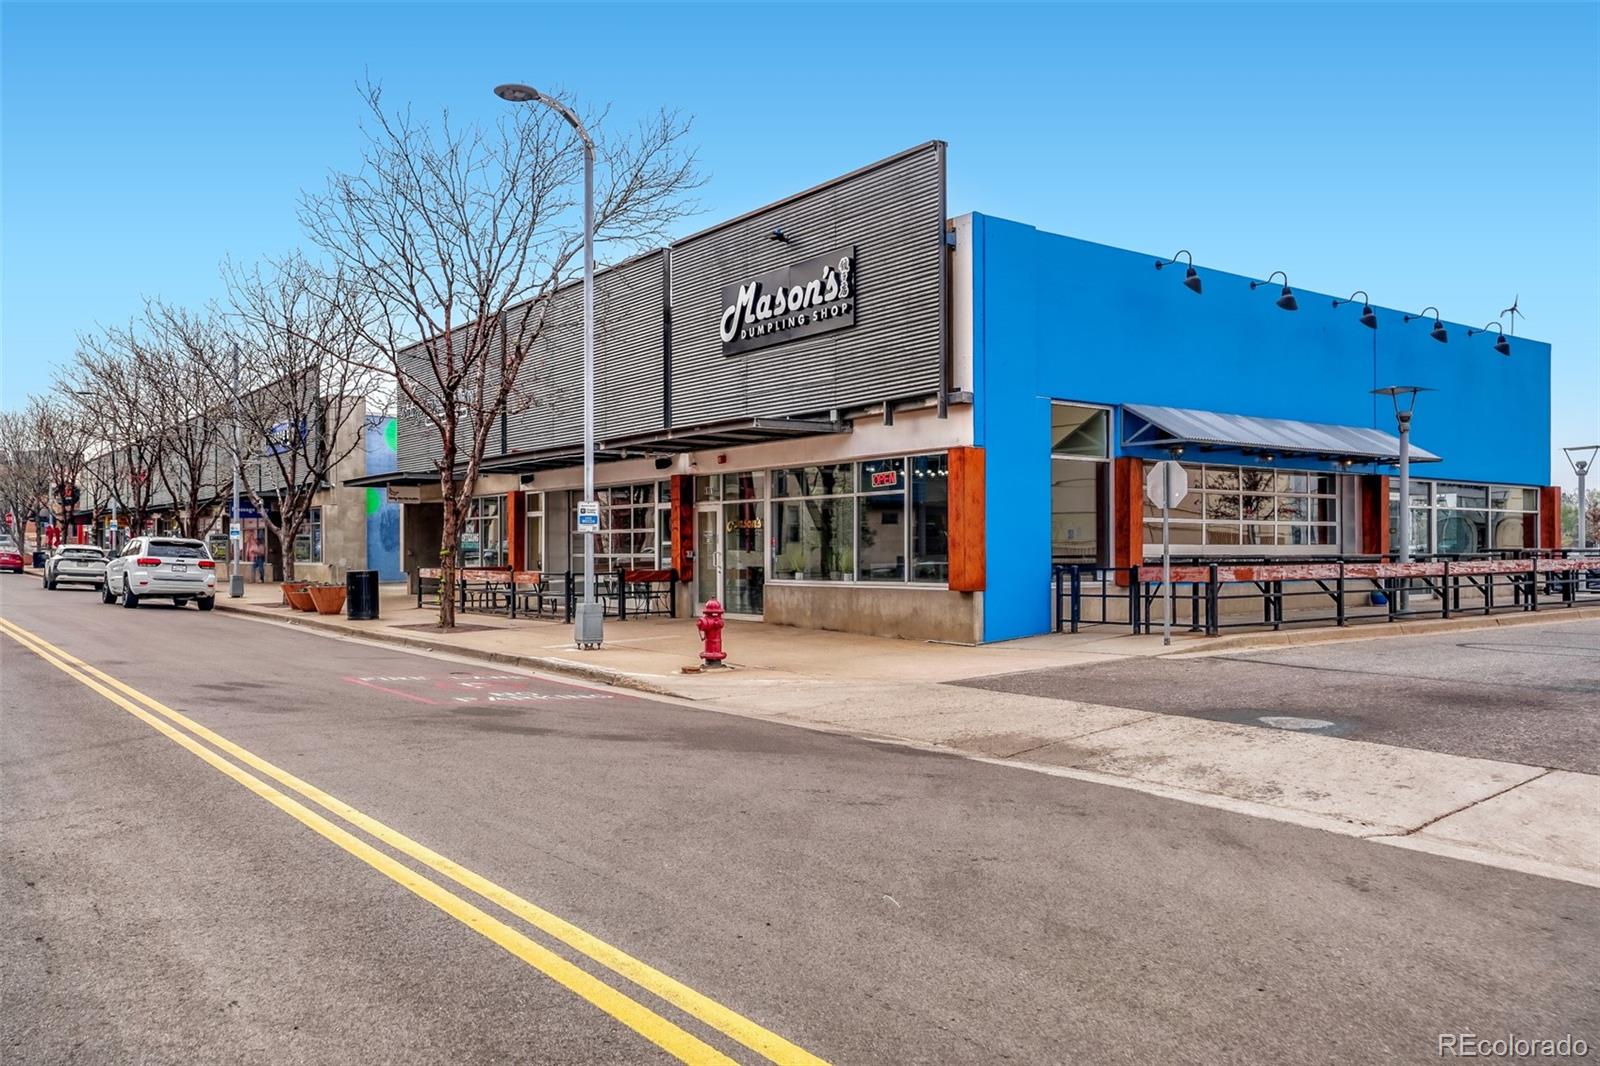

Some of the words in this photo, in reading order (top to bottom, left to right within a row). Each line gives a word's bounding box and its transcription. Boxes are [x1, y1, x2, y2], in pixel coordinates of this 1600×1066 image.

[720, 265, 838, 342] Mason's
[741, 314, 805, 340] DUMPLING
[813, 303, 848, 321] SHOP
[873, 472, 895, 486] OPEN
